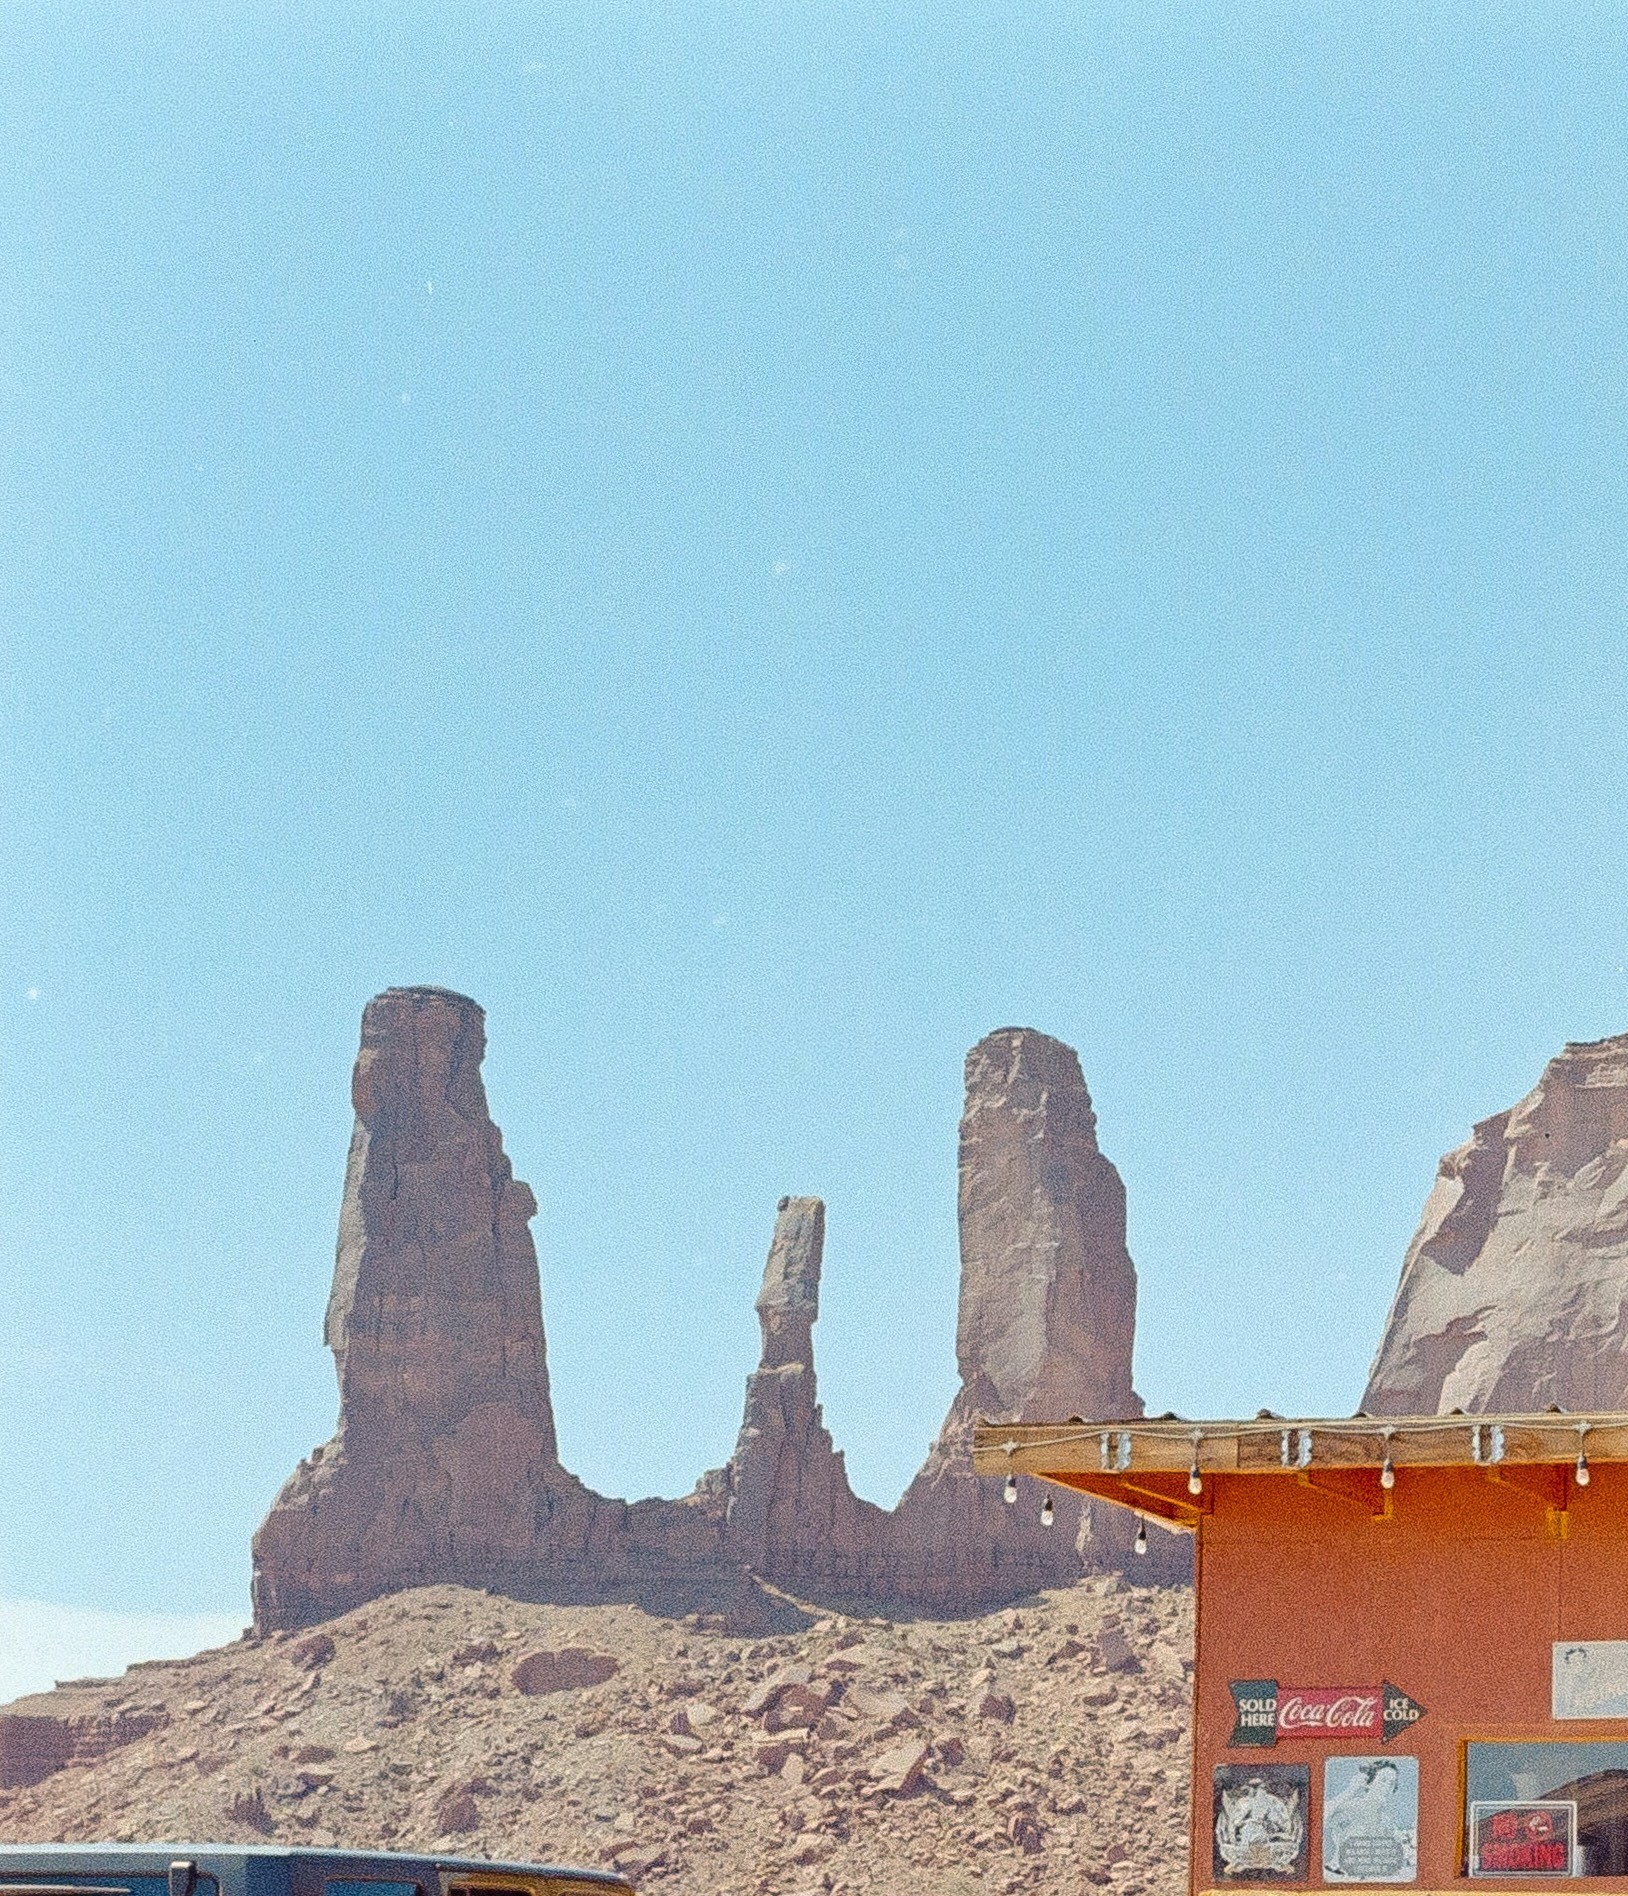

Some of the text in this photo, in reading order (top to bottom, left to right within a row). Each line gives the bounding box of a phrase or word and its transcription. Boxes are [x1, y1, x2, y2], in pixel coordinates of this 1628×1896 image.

[1239, 1699, 1277, 1712] SOLD
[1389, 1699, 1409, 1709] ICE
[1278, 1697, 1375, 1729] Coca-Cola
[1383, 1710, 1420, 1721] COLD
[1241, 1714, 1275, 1727] HERE
[1482, 1842, 1565, 1869] SMOKING
